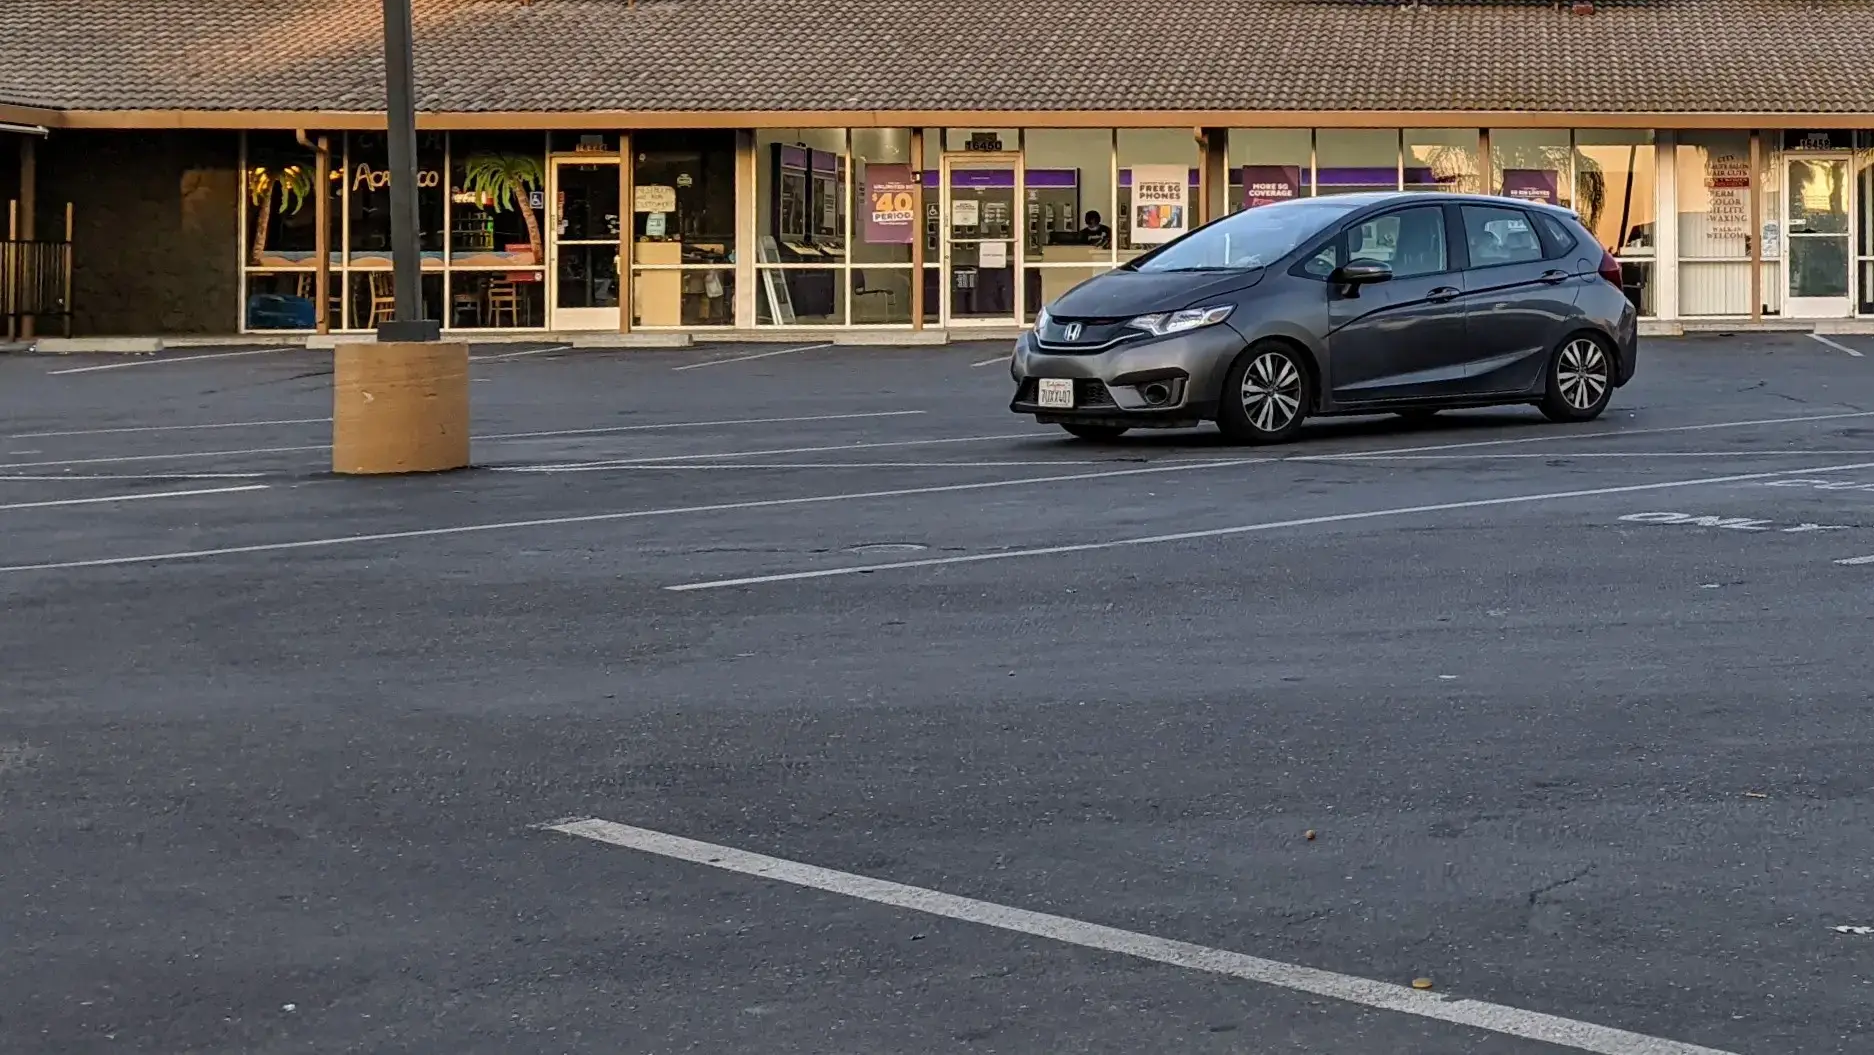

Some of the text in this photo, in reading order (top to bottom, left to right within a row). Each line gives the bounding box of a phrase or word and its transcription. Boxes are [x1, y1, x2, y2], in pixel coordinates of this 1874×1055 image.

[1139, 184, 1165, 192] FREE
[1139, 192, 1181, 200] PHONES
[872, 192, 913, 211] $40
